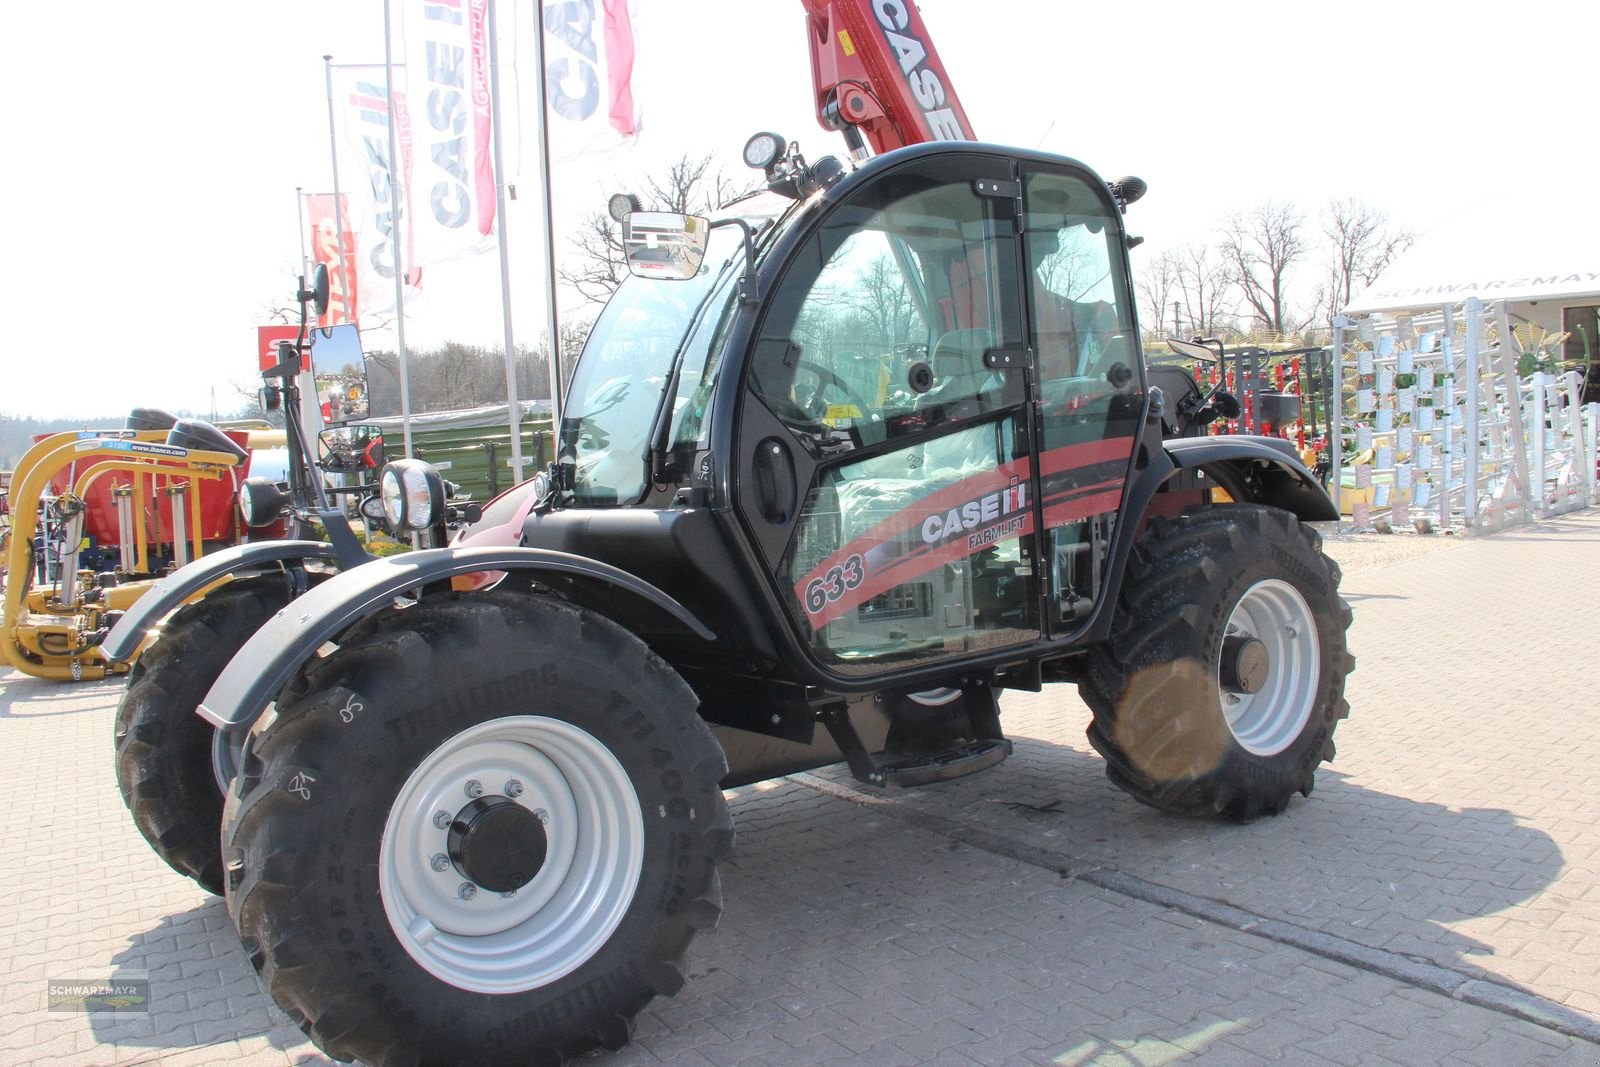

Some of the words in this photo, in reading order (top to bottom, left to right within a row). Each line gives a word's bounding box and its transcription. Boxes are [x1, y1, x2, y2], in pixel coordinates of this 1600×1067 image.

[871, 0, 966, 141] CASE
[426, 40, 471, 229] CASE
[363, 135, 403, 279] CASE
[108, 442, 128, 450] S100
[132, 445, 186, 457] www.itanco.com
[921, 493, 999, 543] CASE
[967, 514, 1027, 550] FARMLIFT
[804, 553, 865, 615] 633
